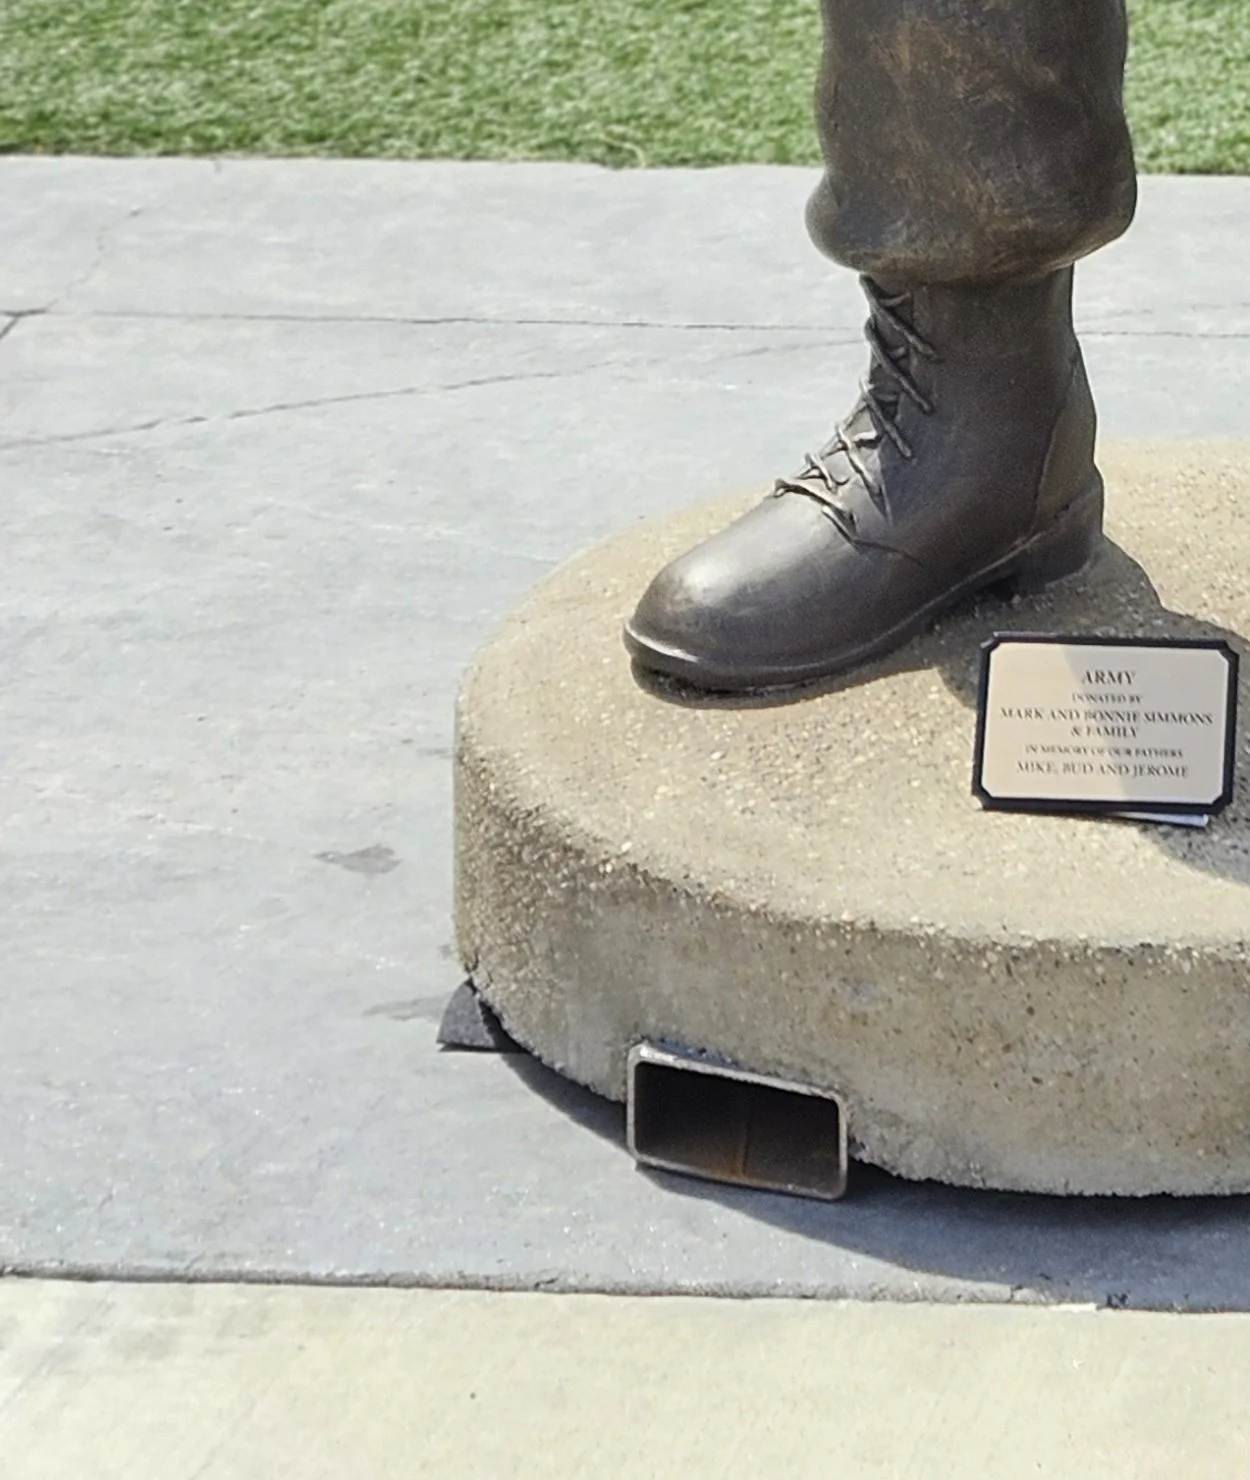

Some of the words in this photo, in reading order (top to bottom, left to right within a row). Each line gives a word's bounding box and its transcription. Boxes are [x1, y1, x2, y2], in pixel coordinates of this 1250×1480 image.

[1081, 670, 1137, 685] ARMY
[1072, 693, 1126, 704] DONATED
[1129, 694, 1142, 704] BY
[1000, 707, 1044, 720] MARK
[1049, 709, 1080, 721] AND
[1084, 709, 1139, 722] BONNIE
[1144, 711, 1214, 725] SIMMONS
[1070, 726, 1081, 737] &
[1086, 726, 1139, 738] FAMILY
[1025, 744, 1037, 753] IN
[1040, 744, 1088, 756] MEMORY
[1091, 746, 1104, 756] OF
[1135, 747, 1183, 758] FATHERS
[1017, 761, 1058, 774] MIKE,
[1062, 762, 1094, 774] BUD
[1099, 763, 1129, 776] AND
[1133, 764, 1188, 778] JEROME
